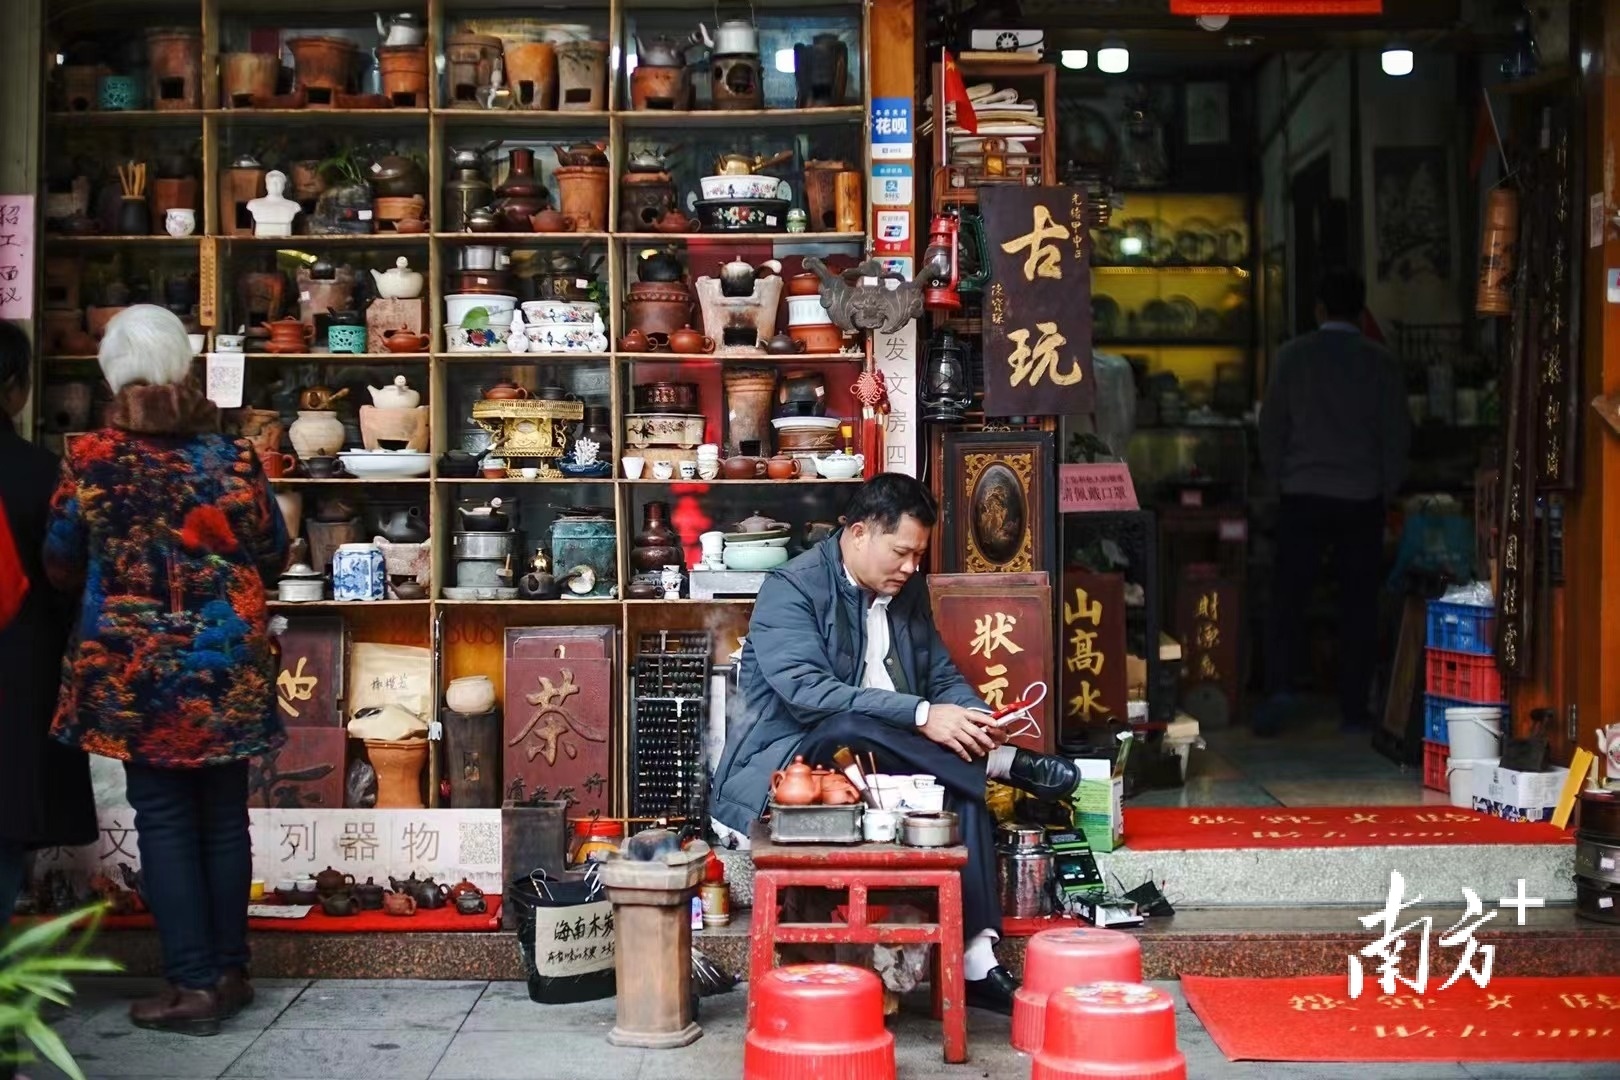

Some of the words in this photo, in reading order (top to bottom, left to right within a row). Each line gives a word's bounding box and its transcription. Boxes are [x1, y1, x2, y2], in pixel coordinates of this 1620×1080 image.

[875, 117, 908, 135] 花呗
[1000, 204, 1083, 388] 古玩
[884, 337, 909, 466] 发文房四
[969, 611, 1025, 711] 狀元
[509, 667, 606, 767] 茶
